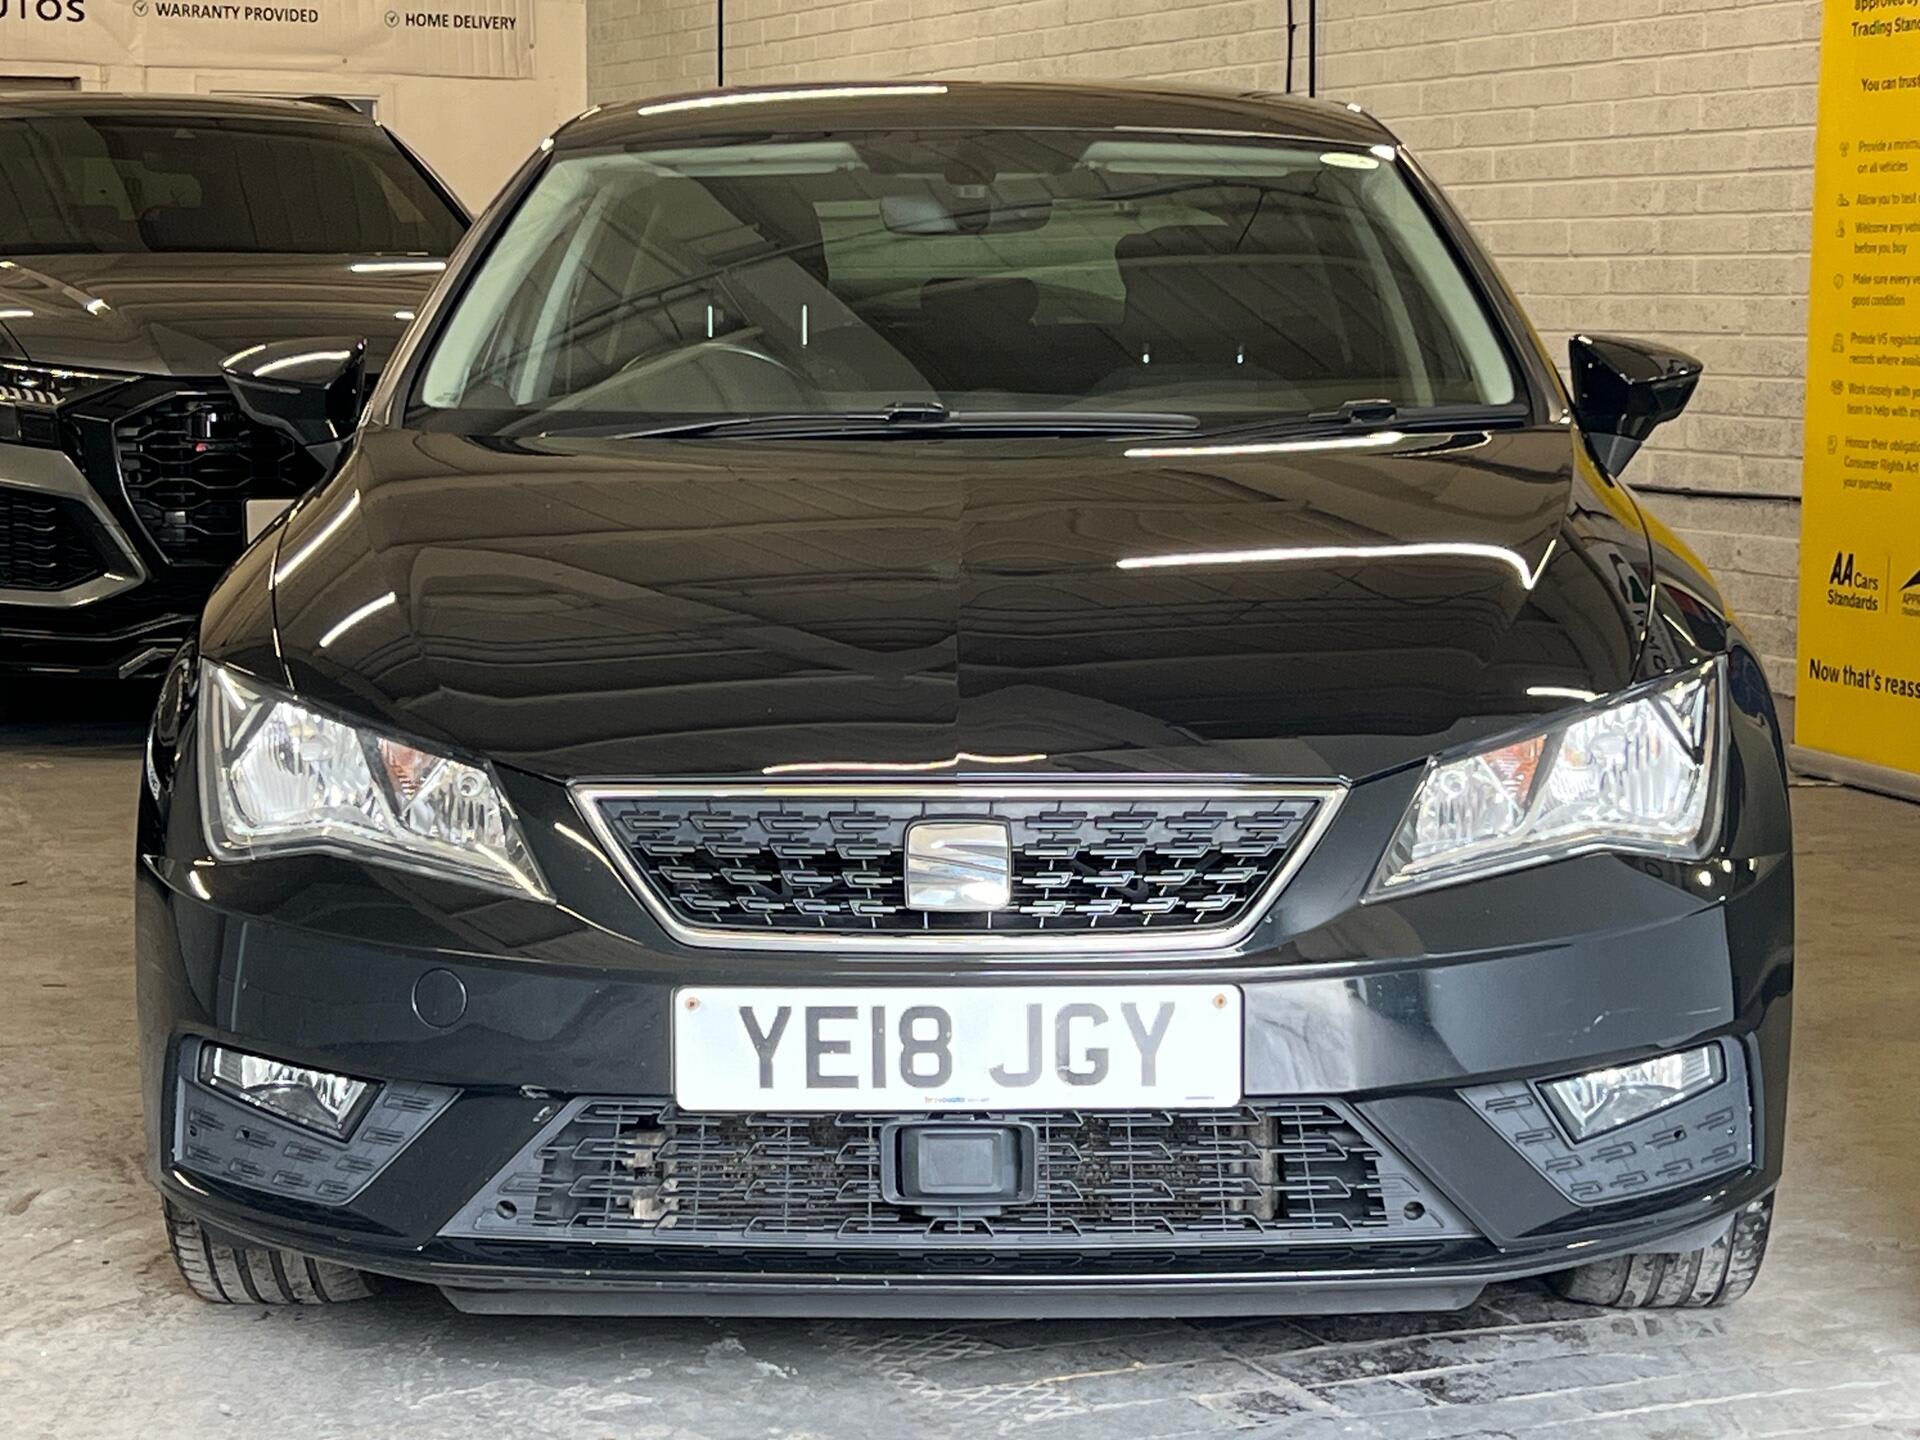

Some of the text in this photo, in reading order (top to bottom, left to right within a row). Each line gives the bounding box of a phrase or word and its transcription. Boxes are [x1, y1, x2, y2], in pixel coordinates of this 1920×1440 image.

[156, 2, 319, 24] WARRANTY PROVIDED
[405, 13, 517, 30] HOME DELIVERY
[1851, 19, 1892, 37] Trading
[1861, 78, 1880, 92] You
[1881, 79, 1896, 91] can
[1829, 550, 1879, 591] AA Cars
[1827, 588, 1878, 611] Standards
[1809, 658, 1840, 684] Now
[1843, 664, 1881, 692] that's
[738, 1001, 1176, 1089] YE18 JGY
